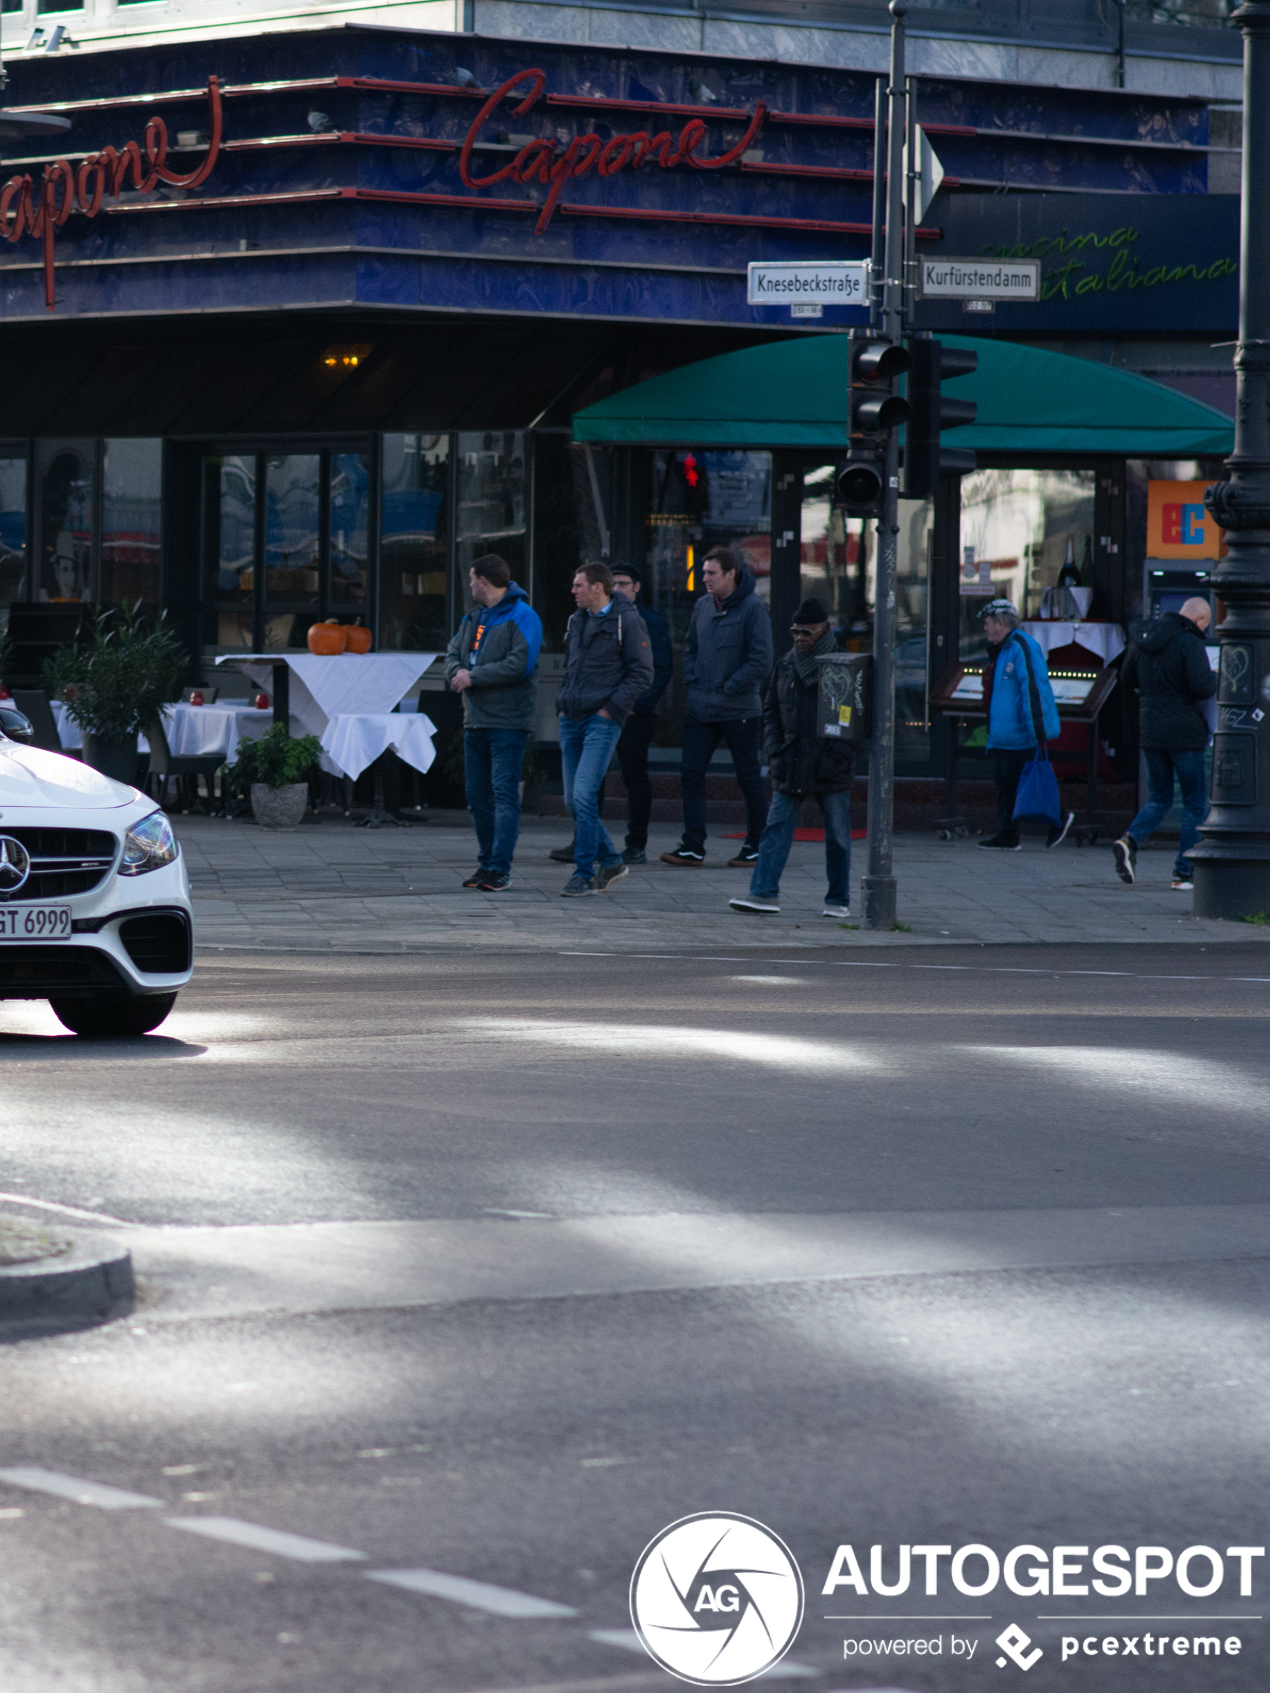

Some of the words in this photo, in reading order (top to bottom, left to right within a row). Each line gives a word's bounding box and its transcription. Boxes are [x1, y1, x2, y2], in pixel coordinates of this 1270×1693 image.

[460, 68, 767, 235] Capone
[757, 274, 860, 296] Knesebeckstraße
[927, 265, 1031, 288] Kurfürstendamm
[24, 910, 69, 934] 6999
